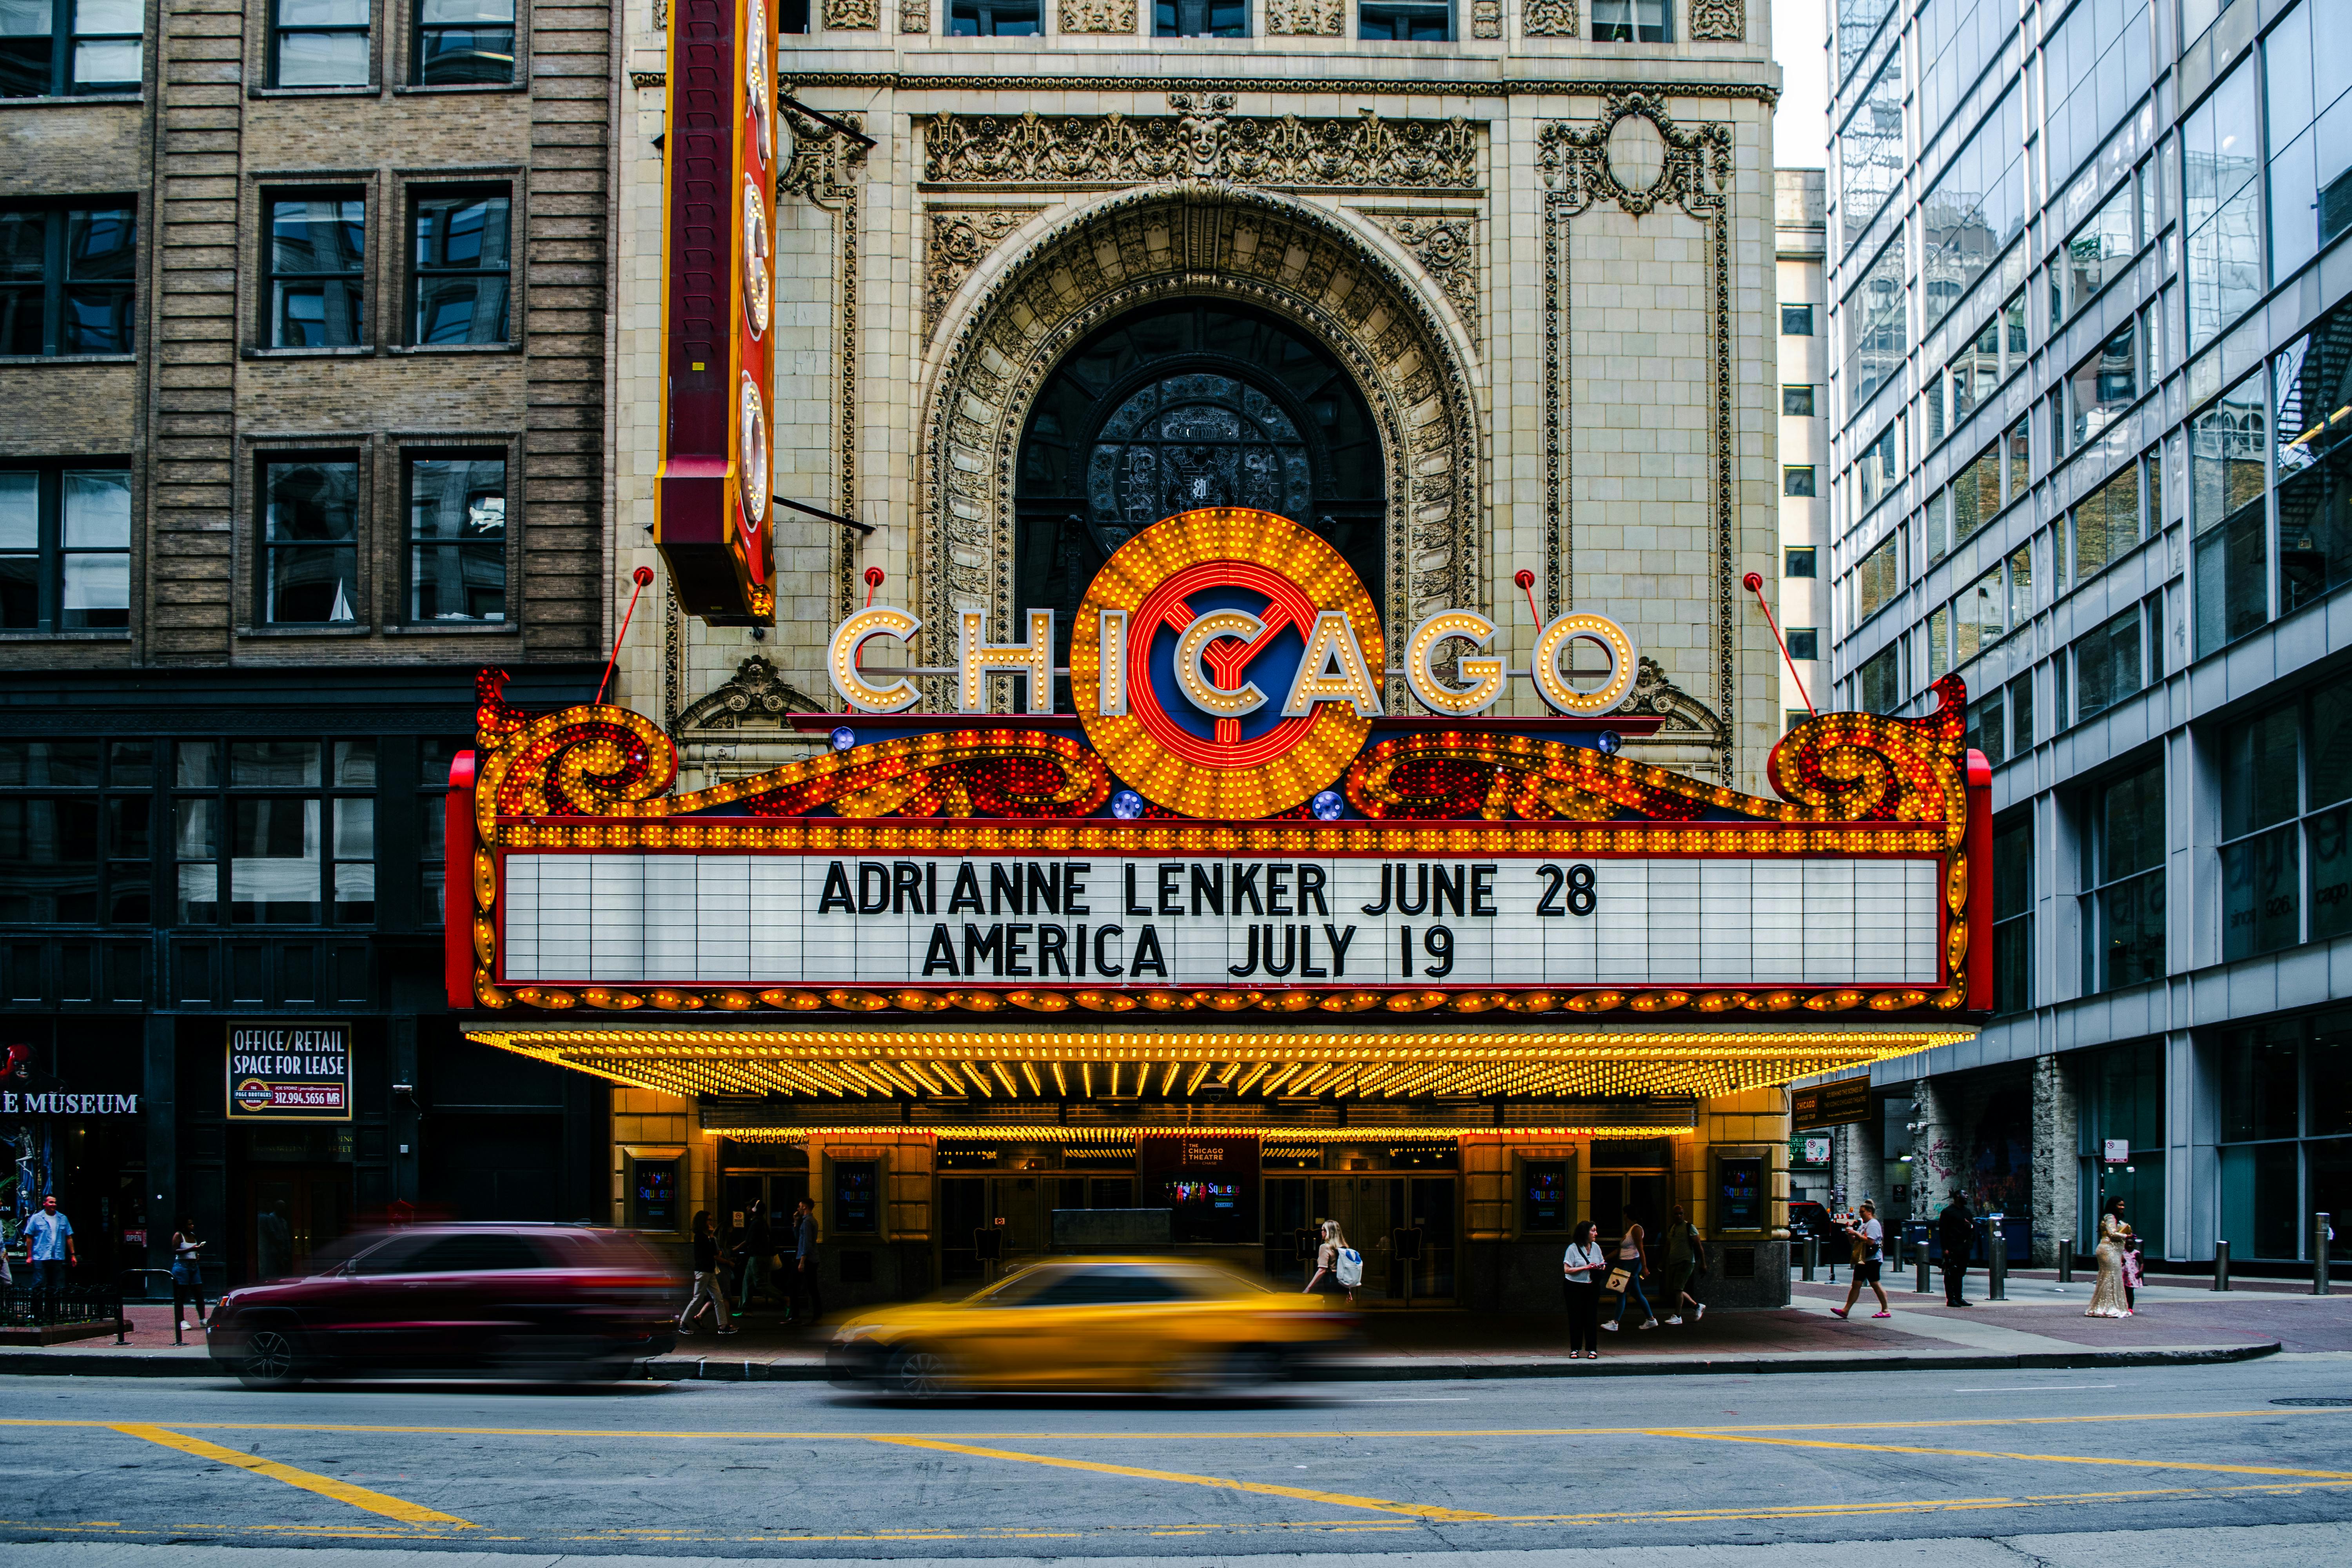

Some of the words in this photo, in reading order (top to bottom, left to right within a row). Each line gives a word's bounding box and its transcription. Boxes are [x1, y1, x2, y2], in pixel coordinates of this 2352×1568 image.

[827, 606, 1639, 717] CHICAGO
[818, 861, 1091, 916] ADRIANNE
[1125, 862, 1329, 916] LENKER
[1361, 863, 1498, 917] JUNE
[1535, 864, 1597, 917] 28
[922, 923, 1168, 977] AMERICA
[1228, 924, 1357, 978] JULY
[1401, 925, 1454, 978] 19
[235, 1030, 345, 1052] OFFICE/RETAIL
[234, 1055, 272, 1074] SPACE
[276, 1056, 301, 1074] FOR
[305, 1056, 345, 1074] LEASE
[25, 1093, 138, 1114] MUSEUM
[274, 1092, 325, 1104] 312.994.5656
[327, 1093, 340, 1102] MR
[1797, 1100, 1815, 1110] CHICAGO
[1626, 1142, 1644, 1152] WILL
[639, 1187, 674, 1200] Squeeze
[1209, 1183, 1240, 1195] Squeeze
[1530, 1188, 1564, 1201] Squeeze
[1724, 1185, 1759, 1198] Squeeze
